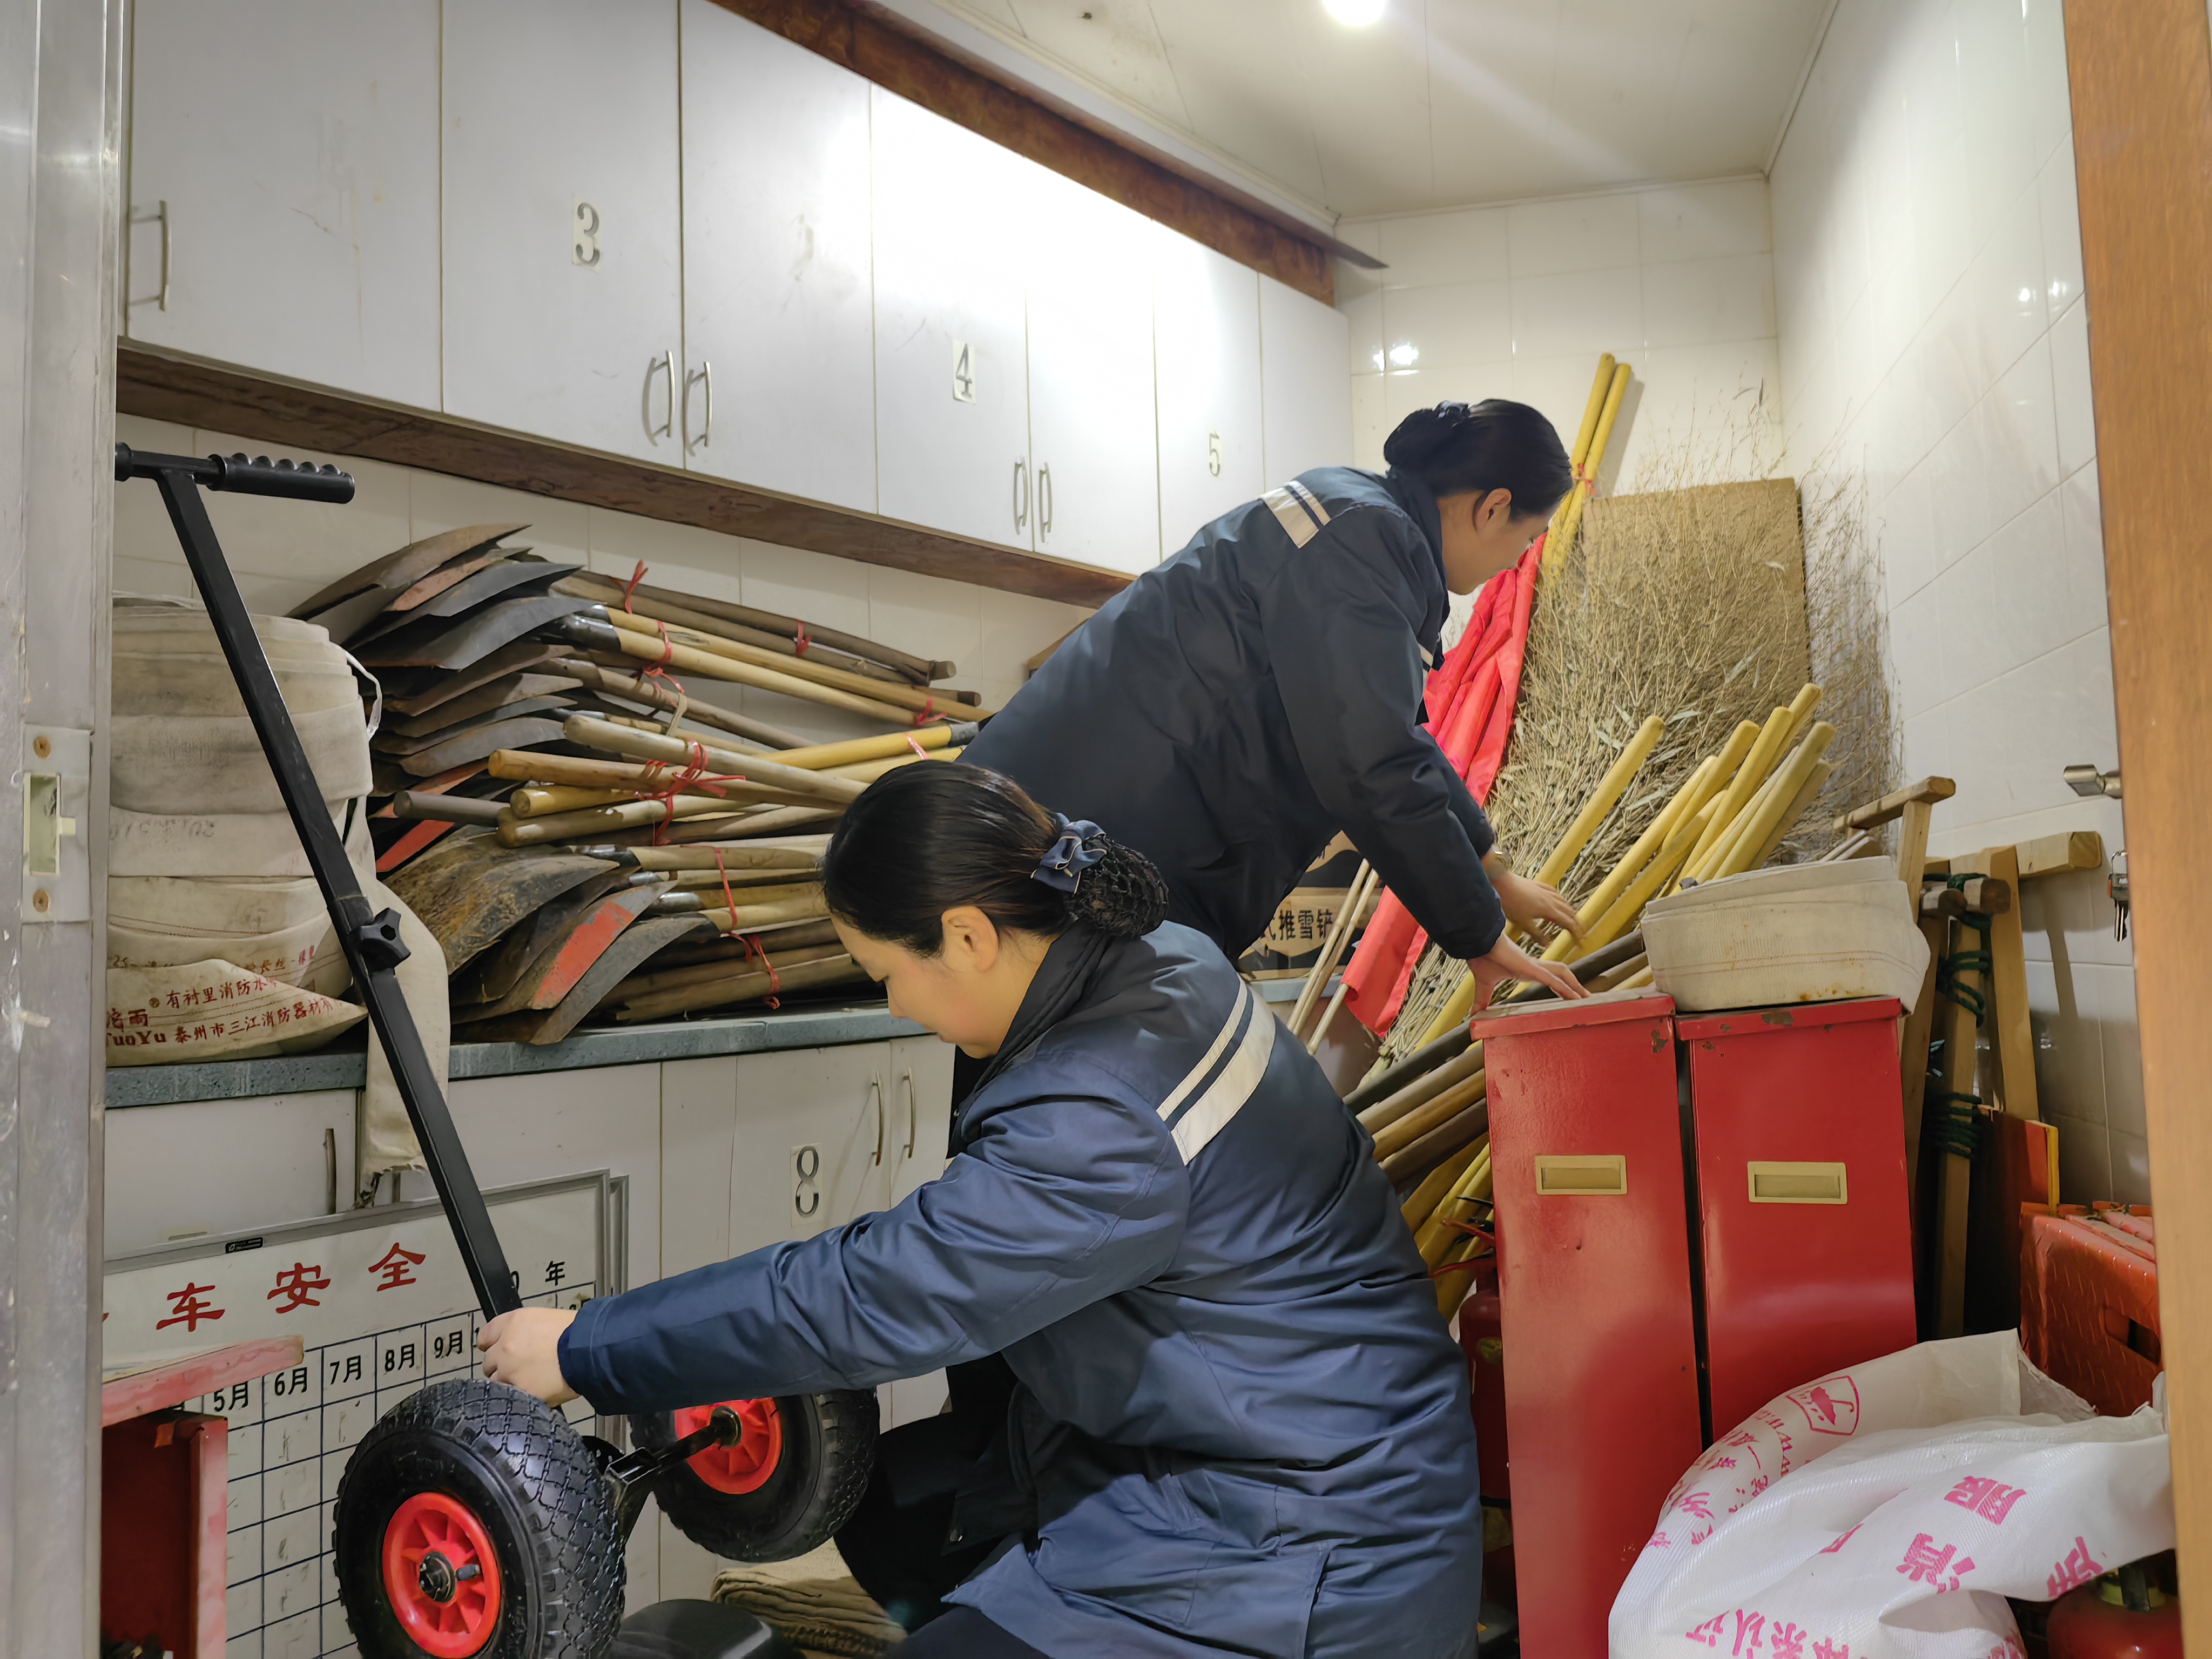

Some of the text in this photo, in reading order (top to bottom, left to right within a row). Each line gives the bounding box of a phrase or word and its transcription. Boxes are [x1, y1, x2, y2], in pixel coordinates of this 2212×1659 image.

[576, 203, 600, 267] 3
[956, 343, 973, 399] 4
[1209, 433, 1220, 477] 5
[174, 997, 342, 1044] 泰州市三江消防器材有
[795, 1145, 819, 1218] 8
[103, 1242, 426, 1332] 车安全
[214, 1381, 249, 1412] 5月
[274, 1367, 308, 1397] 6月
[330, 1354, 362, 1385] 7月
[385, 1343, 415, 1372] 8月
[434, 1331, 463, 1359] 9月
